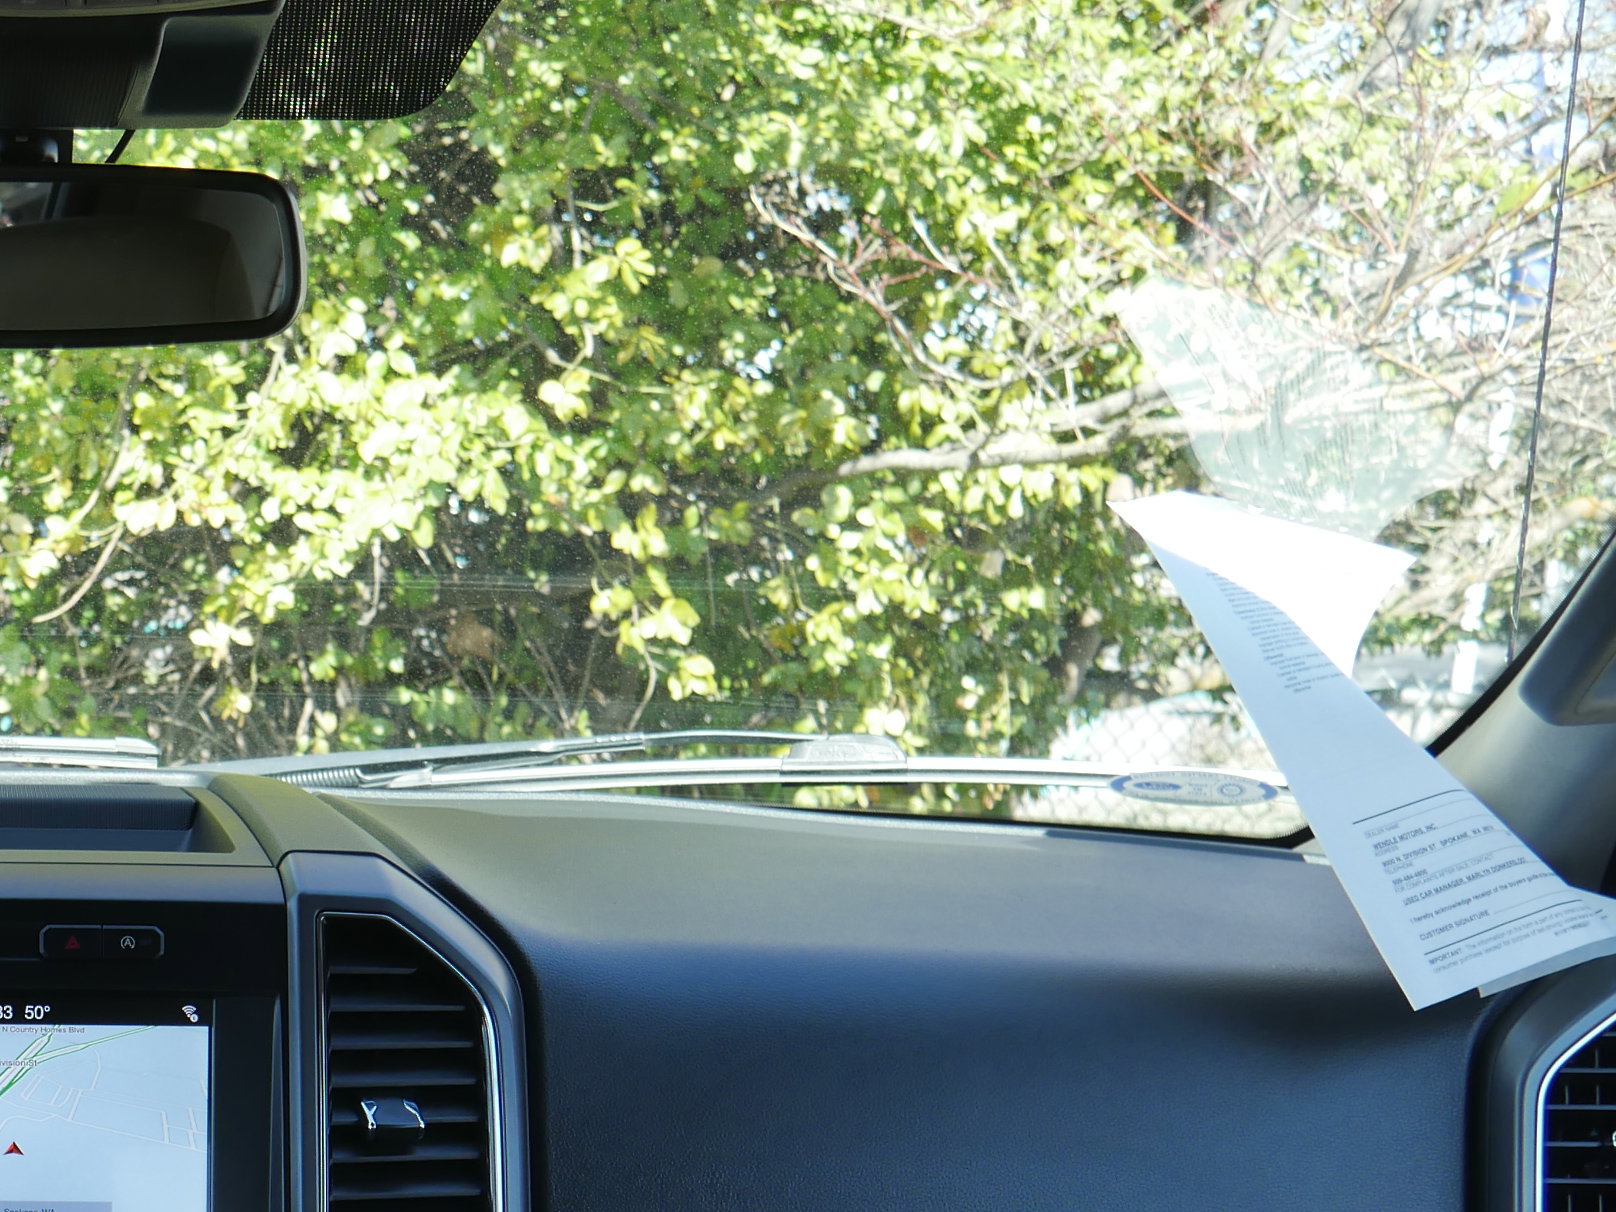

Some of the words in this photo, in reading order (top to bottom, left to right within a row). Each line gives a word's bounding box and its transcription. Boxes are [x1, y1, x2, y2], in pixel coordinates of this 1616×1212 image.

[1403, 895, 1419, 905] USED
[1420, 890, 1433, 899] CAR
[1414, 912, 1434, 924] hereby
[1434, 897, 1472, 916] acknowledge
[1419, 924, 1454, 941] CUSTOMER
[1454, 910, 1490, 928] SIGNATURE
[24, 1005, 51, 1020] 50°
[9, 1026, 38, 1036] Country
[69, 1026, 85, 1034] Blvd
